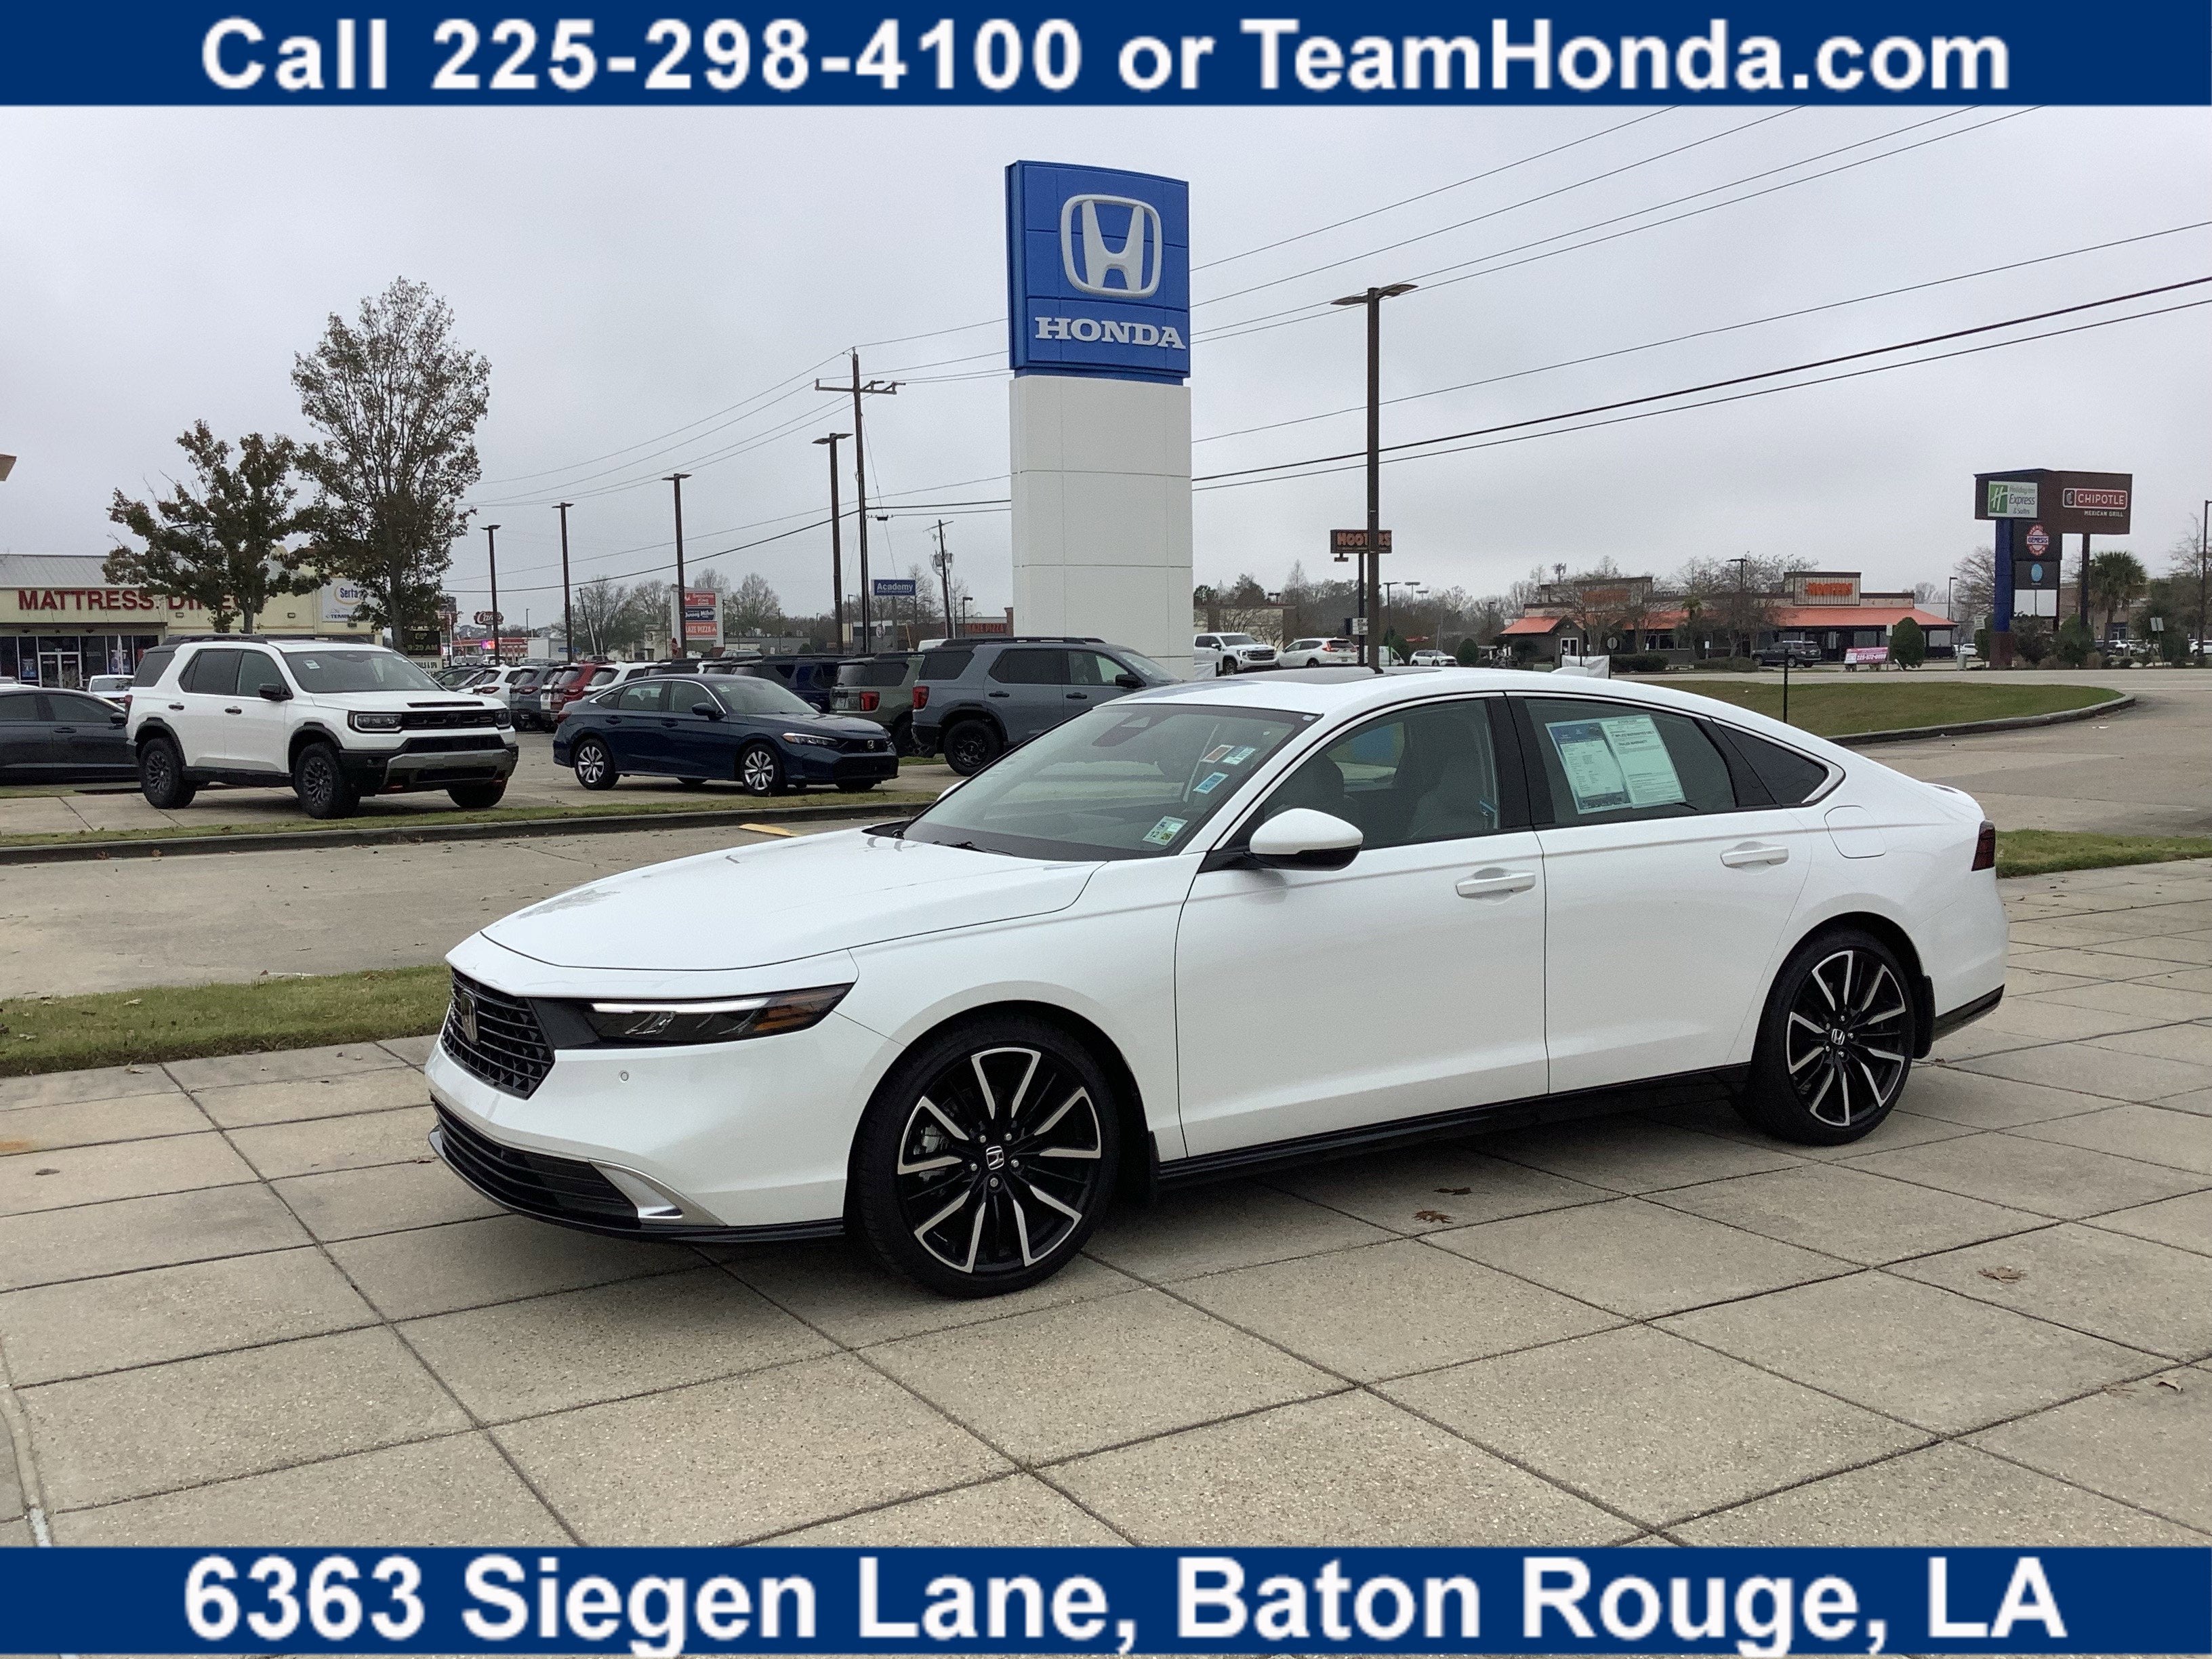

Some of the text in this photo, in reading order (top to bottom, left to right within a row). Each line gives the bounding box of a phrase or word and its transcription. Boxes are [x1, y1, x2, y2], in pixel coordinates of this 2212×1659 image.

[1035, 317, 1186, 350] HONDA
[2009, 494, 2035, 506] Express
[2078, 493, 2125, 505] CHIPOTLE
[340, 588, 359, 598] Serta
[877, 583, 914, 592] Academy
[18, 590, 155, 610] MATTRESS
